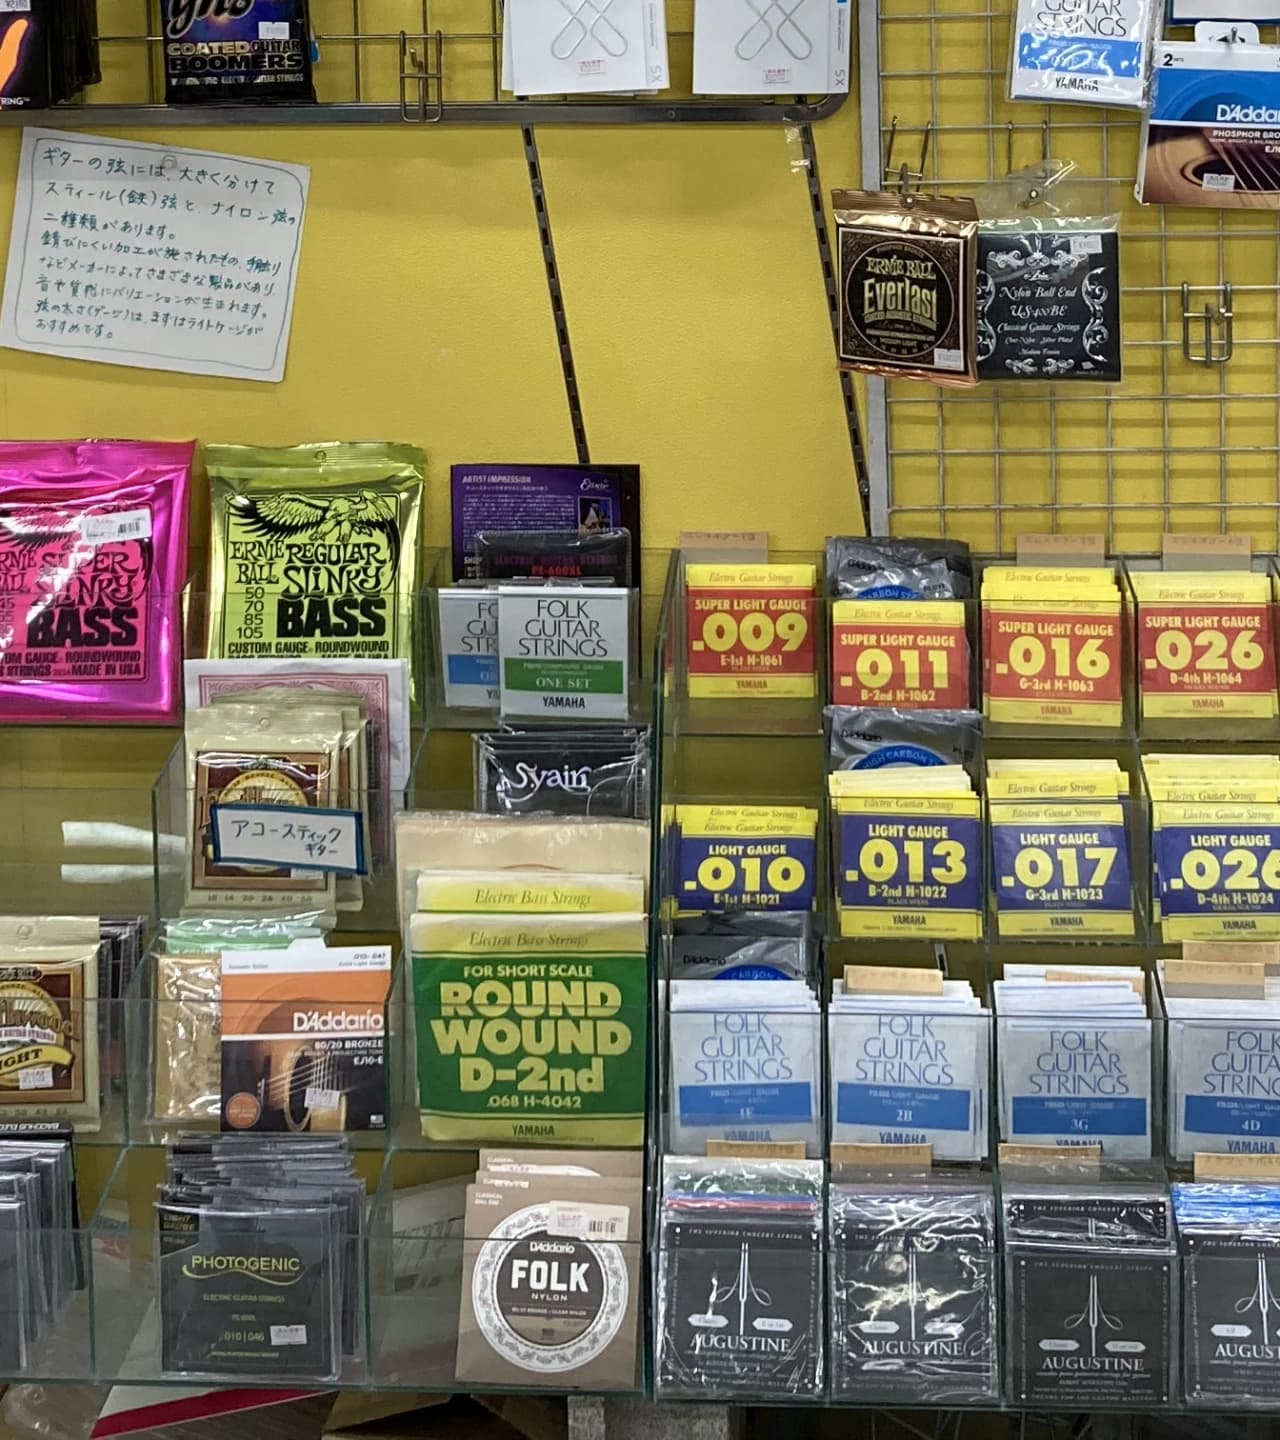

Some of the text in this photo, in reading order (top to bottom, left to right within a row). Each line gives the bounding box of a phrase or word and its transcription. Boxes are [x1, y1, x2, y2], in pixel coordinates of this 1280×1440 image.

[864, 277, 937, 320] Everlast
[285, 543, 386, 566] REGULAR
[283, 565, 385, 599] SLINKY
[537, 600, 589, 619] FOLK
[695, 599, 807, 611] SUPER LIGHT GAUGE
[277, 597, 386, 638] BASS
[525, 620, 602, 639] GUITAR
[692, 611, 808, 652] .009
[228, 640, 389, 654] CUSTOM GAUGE ROUNDWOUND
[518, 638, 608, 658] STRINGS
[995, 636, 1111, 679] .016
[840, 648, 949, 688] .011
[536, 677, 592, 689] ONE SET
[543, 696, 586, 709] YAMAHA
[231, 819, 342, 843] アコースティック
[304, 842, 339, 858] ギター
[846, 838, 967, 883] .013
[1002, 846, 1118, 887] .017
[464, 965, 593, 978] FOR SHORT SCALE
[440, 980, 622, 1017] ROUND
[430, 1019, 632, 1055] WOUND
[459, 1057, 605, 1093] D-2nd
[524, 1096, 581, 1108] H-4042
[512, 1123, 555, 1137] YAMAHA
[192, 1255, 300, 1272] PHOTOGENIC
[511, 1260, 590, 1293] FOLK
[531, 1293, 568, 1302] NYLON
